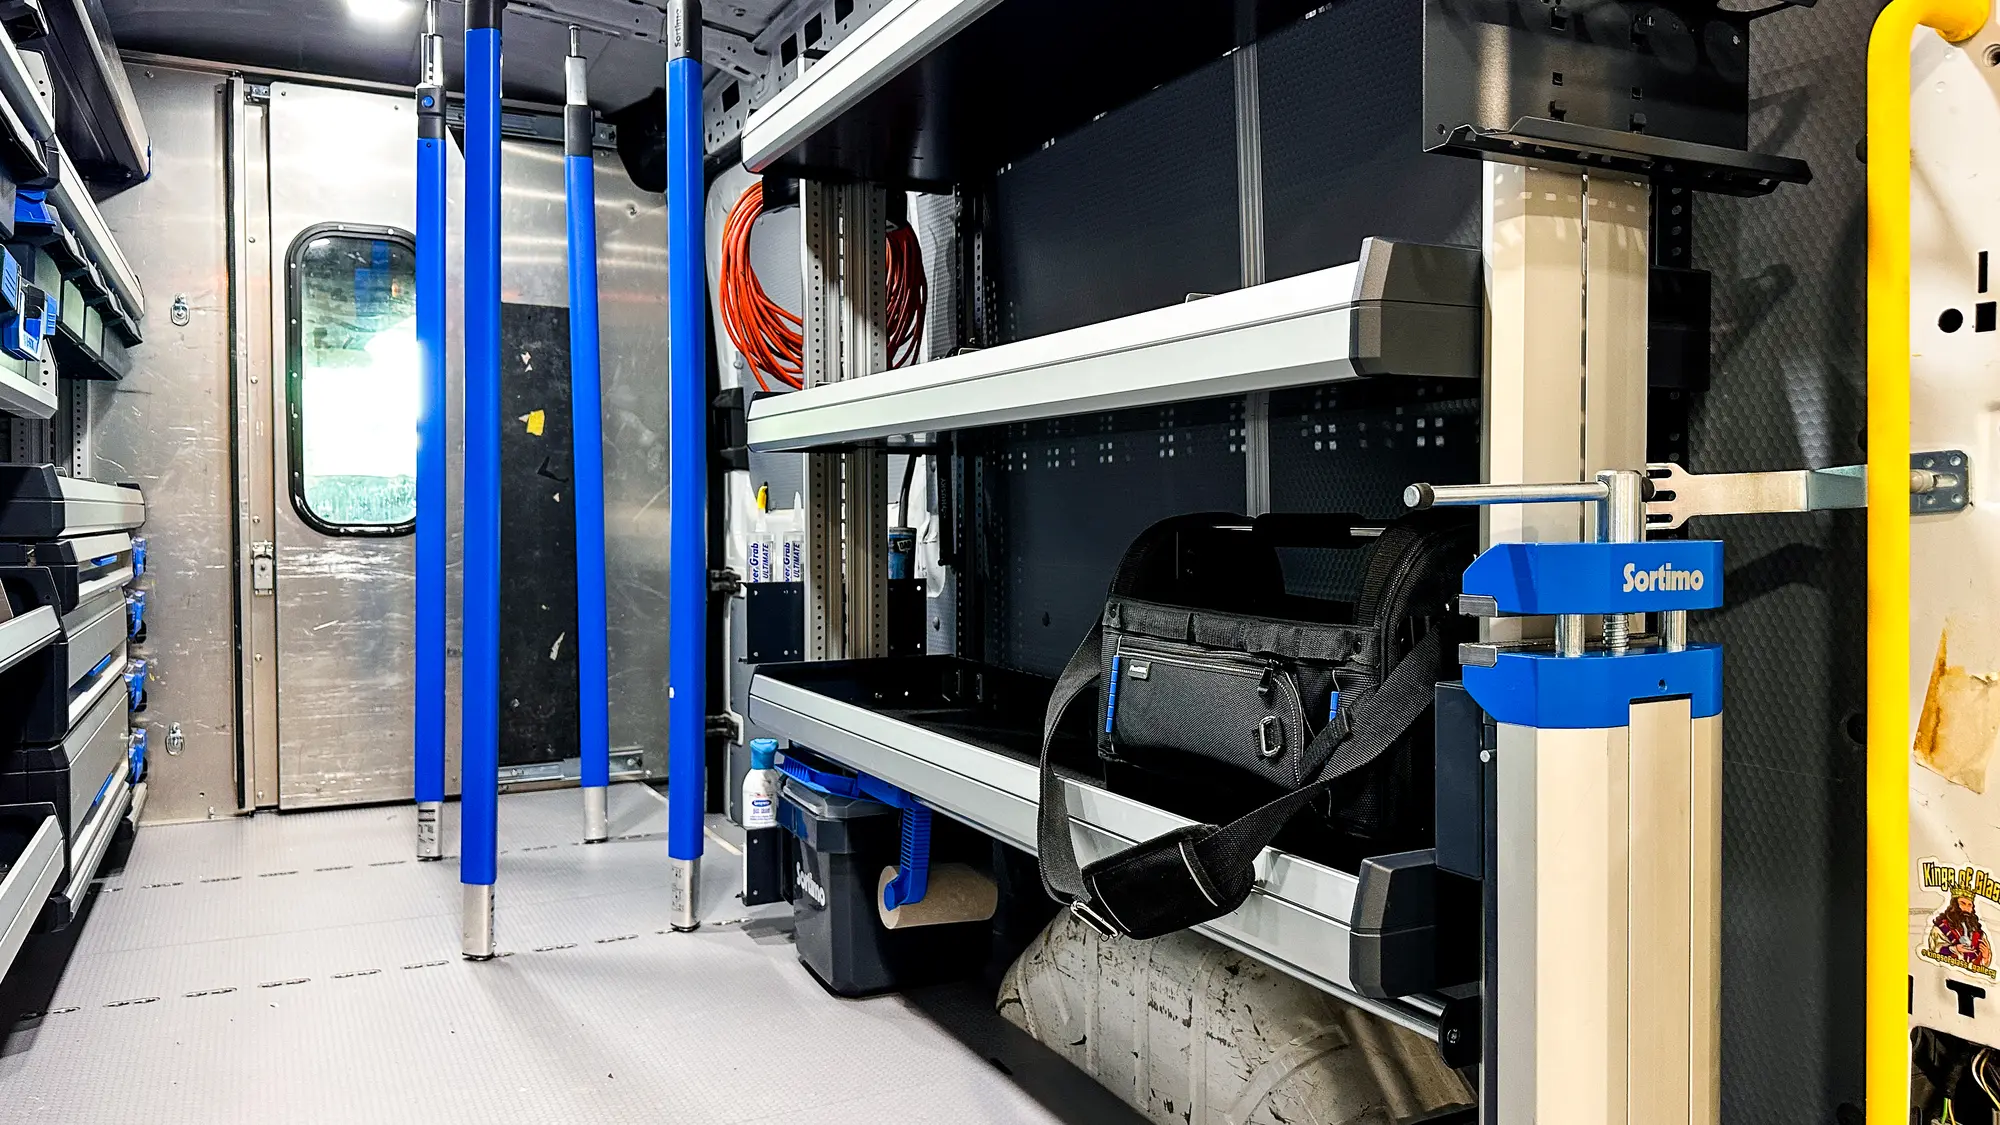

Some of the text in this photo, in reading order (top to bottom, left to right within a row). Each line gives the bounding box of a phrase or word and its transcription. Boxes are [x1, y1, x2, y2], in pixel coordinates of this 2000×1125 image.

[674, 8, 682, 47] Sortimo
[750, 543, 759, 567] Grab
[1623, 562, 1704, 592] Sortimo
[796, 861, 825, 906] Sortimo
[1922, 862, 2000, 904] Kings of Glas
